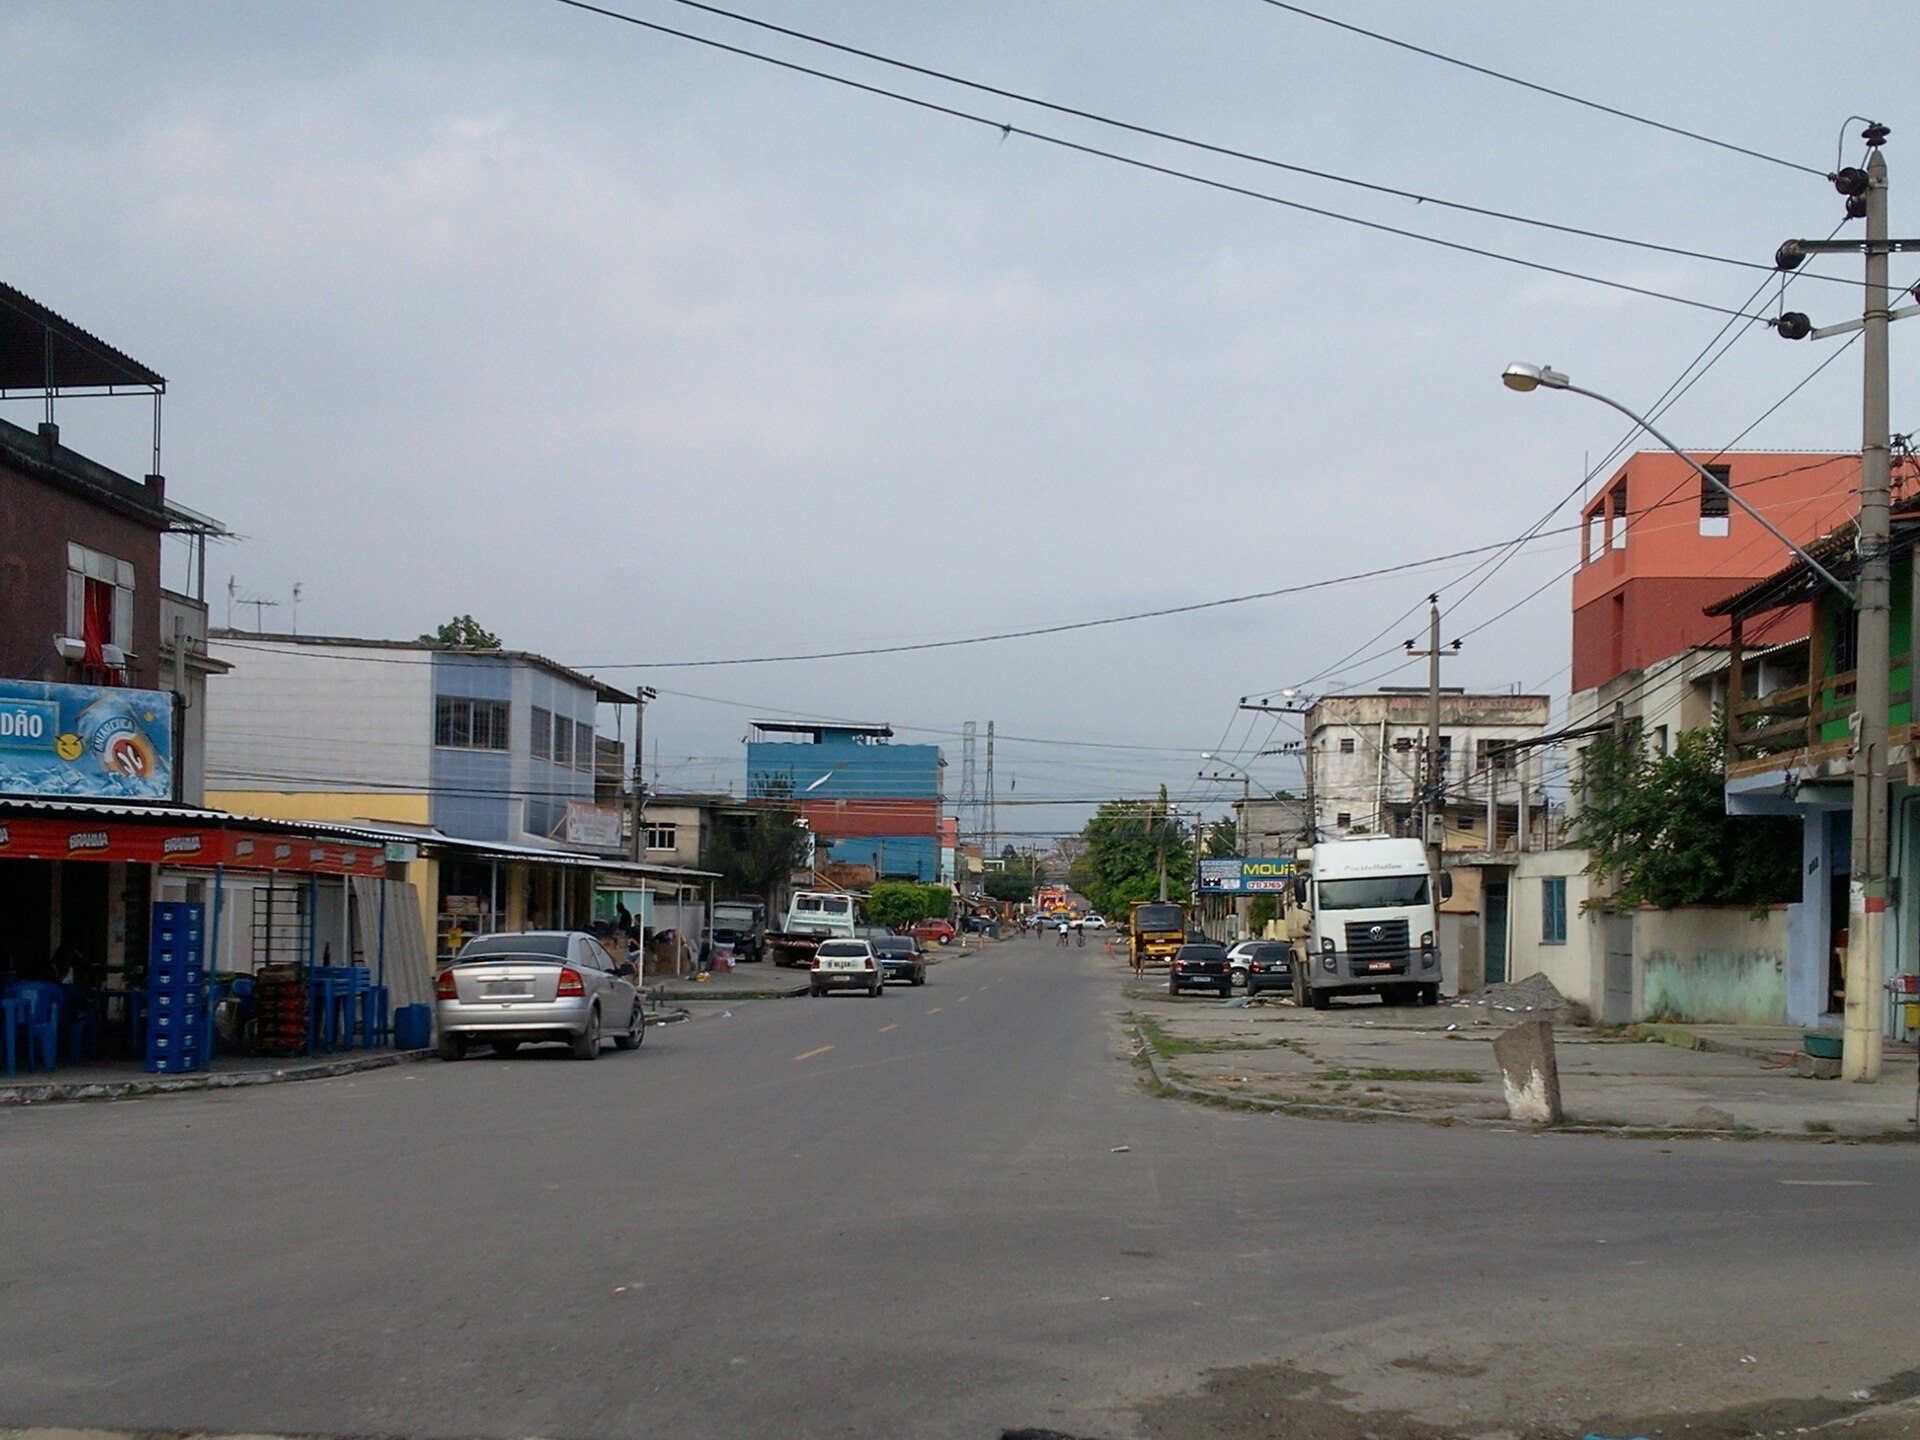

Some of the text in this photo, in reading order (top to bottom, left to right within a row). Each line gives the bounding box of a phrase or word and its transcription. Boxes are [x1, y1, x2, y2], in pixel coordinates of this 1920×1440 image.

[0, 709, 43, 738] DÃO
[94, 716, 135, 751] ANTARCTICA
[69, 832, 109, 849] BRAHMA
[164, 836, 201, 853] BRAHMA
